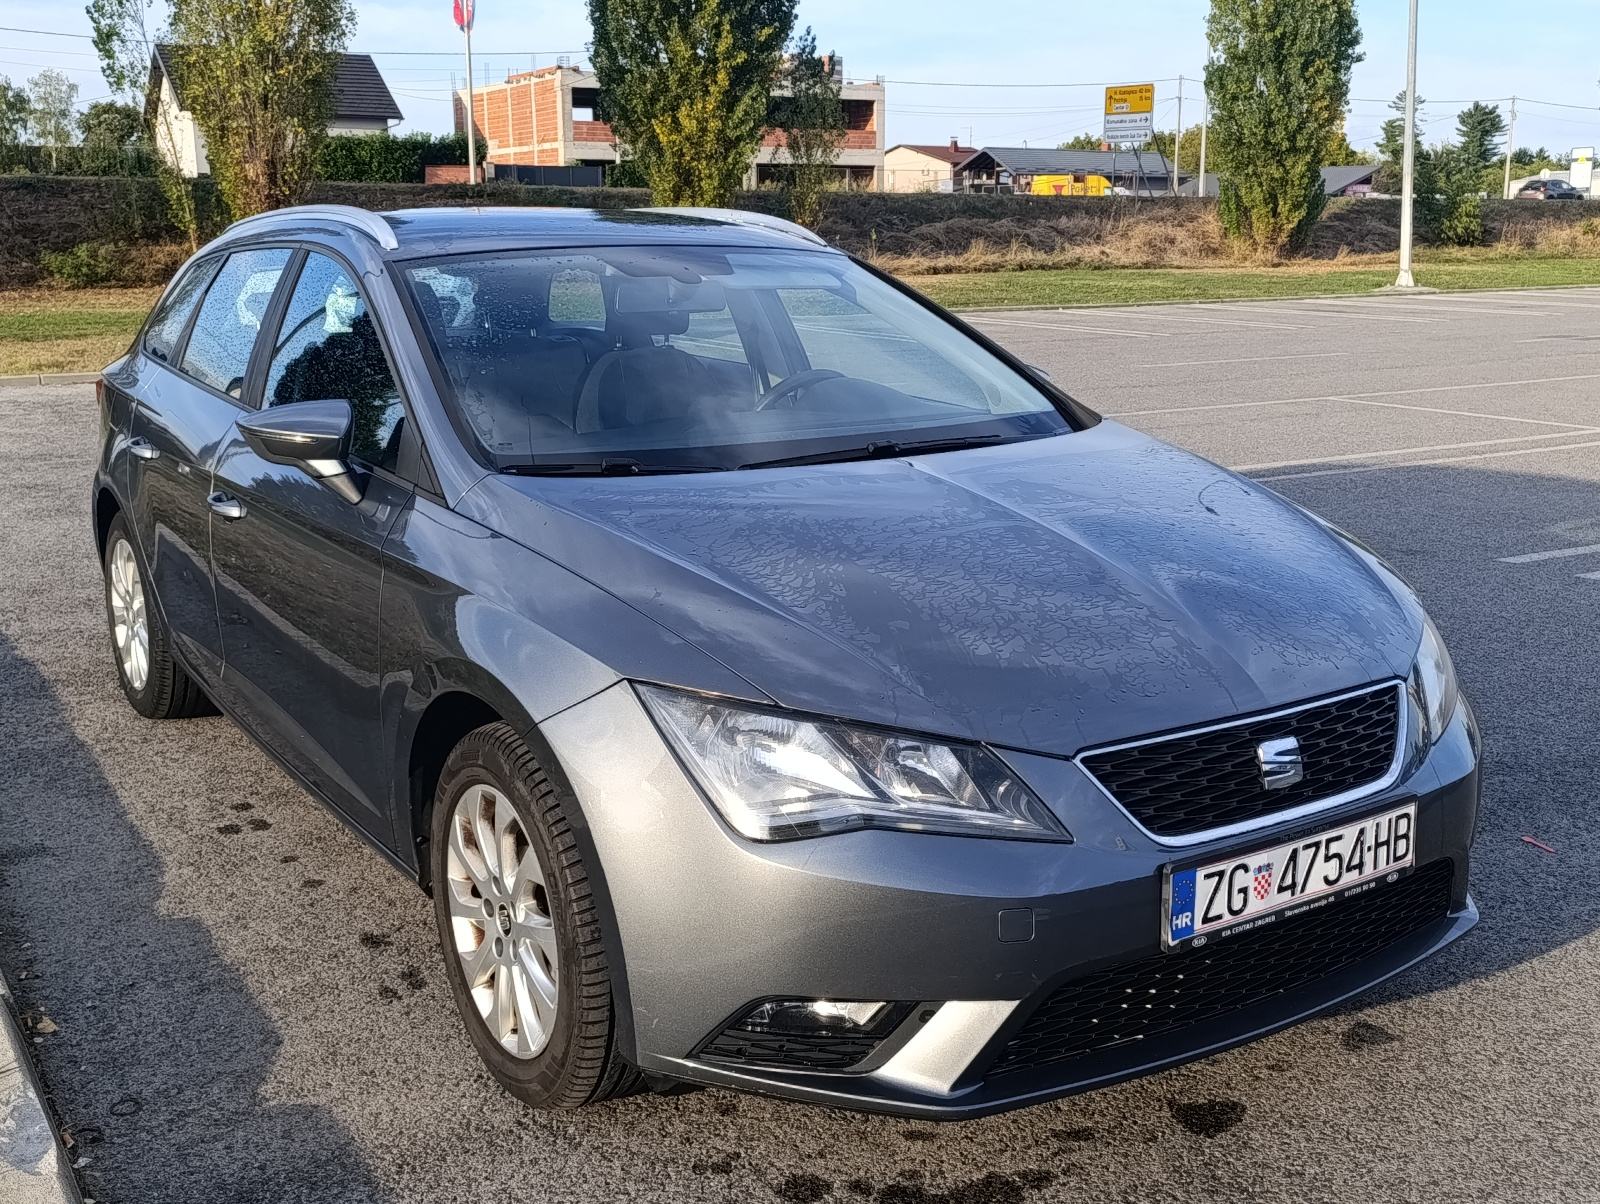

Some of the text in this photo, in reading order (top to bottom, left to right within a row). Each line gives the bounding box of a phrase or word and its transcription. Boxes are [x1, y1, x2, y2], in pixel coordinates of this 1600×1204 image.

[1201, 863, 1251, 925] ZG
[1172, 911, 1192, 931] HR
[1221, 915, 1276, 937] KIA CENTAR ZAGREB
